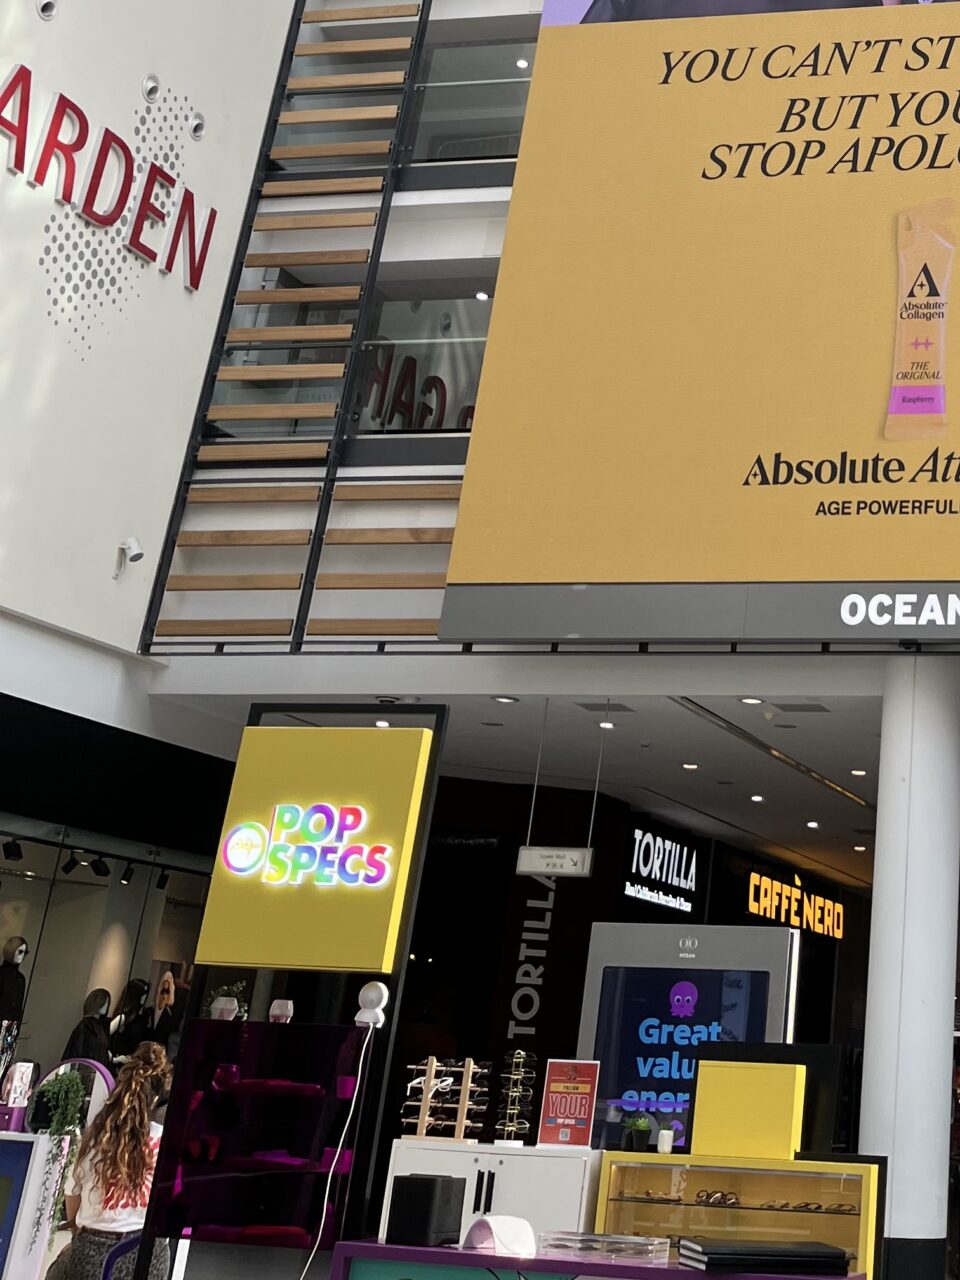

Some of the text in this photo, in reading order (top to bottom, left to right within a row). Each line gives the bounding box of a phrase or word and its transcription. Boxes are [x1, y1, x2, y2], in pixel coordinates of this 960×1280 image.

[658, 47, 758, 85] YOU
[762, 38, 903, 78] CAN’T
[776, 94, 879, 133] BUT
[701, 139, 826, 180] STOP
[0, 64, 217, 292] ARDEN
[900, 310, 945, 321] Collagen
[896, 370, 942, 381] ORIGINAL
[910, 361, 930, 371] THE
[901, 395, 935, 404] Raspberry
[742, 451, 905, 486] Absolute
[815, 501, 852, 516] AGE
[270, 803, 367, 845] POP
[262, 843, 392, 886] SPECS
[632, 828, 697, 892] TORTILLA
[748, 872, 844, 939] CAFFÈ NERO
[638, 1017, 722, 1046] Great
[636, 1051, 696, 1080] valu
[549, 1092, 590, 1118] YOUR
[621, 1089, 690, 1113] ener
